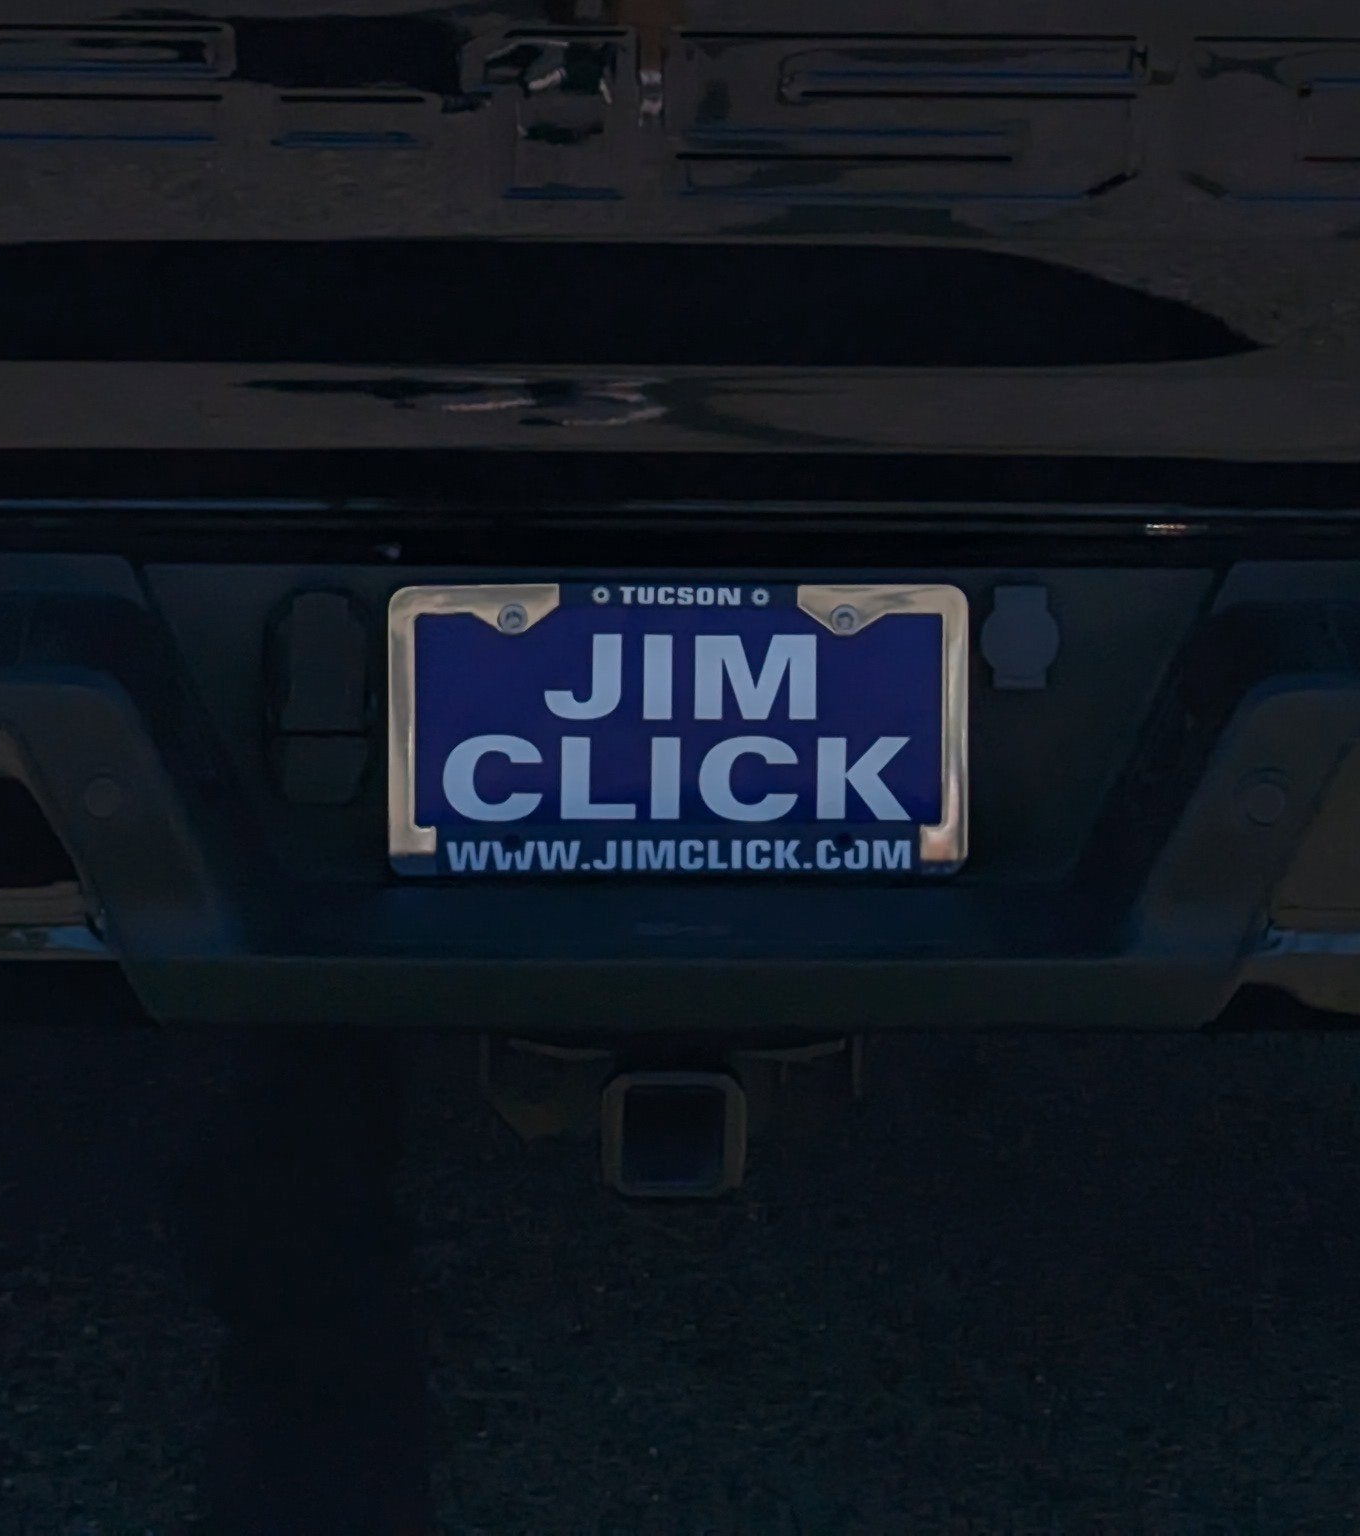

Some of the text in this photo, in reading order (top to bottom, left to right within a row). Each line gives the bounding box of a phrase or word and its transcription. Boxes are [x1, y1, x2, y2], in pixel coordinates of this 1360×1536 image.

[619, 586, 742, 606] TUCSON
[544, 633, 817, 721] JIM
[442, 734, 912, 823] CLICK
[446, 838, 912, 873] WWW.JIMCLICK.COM
